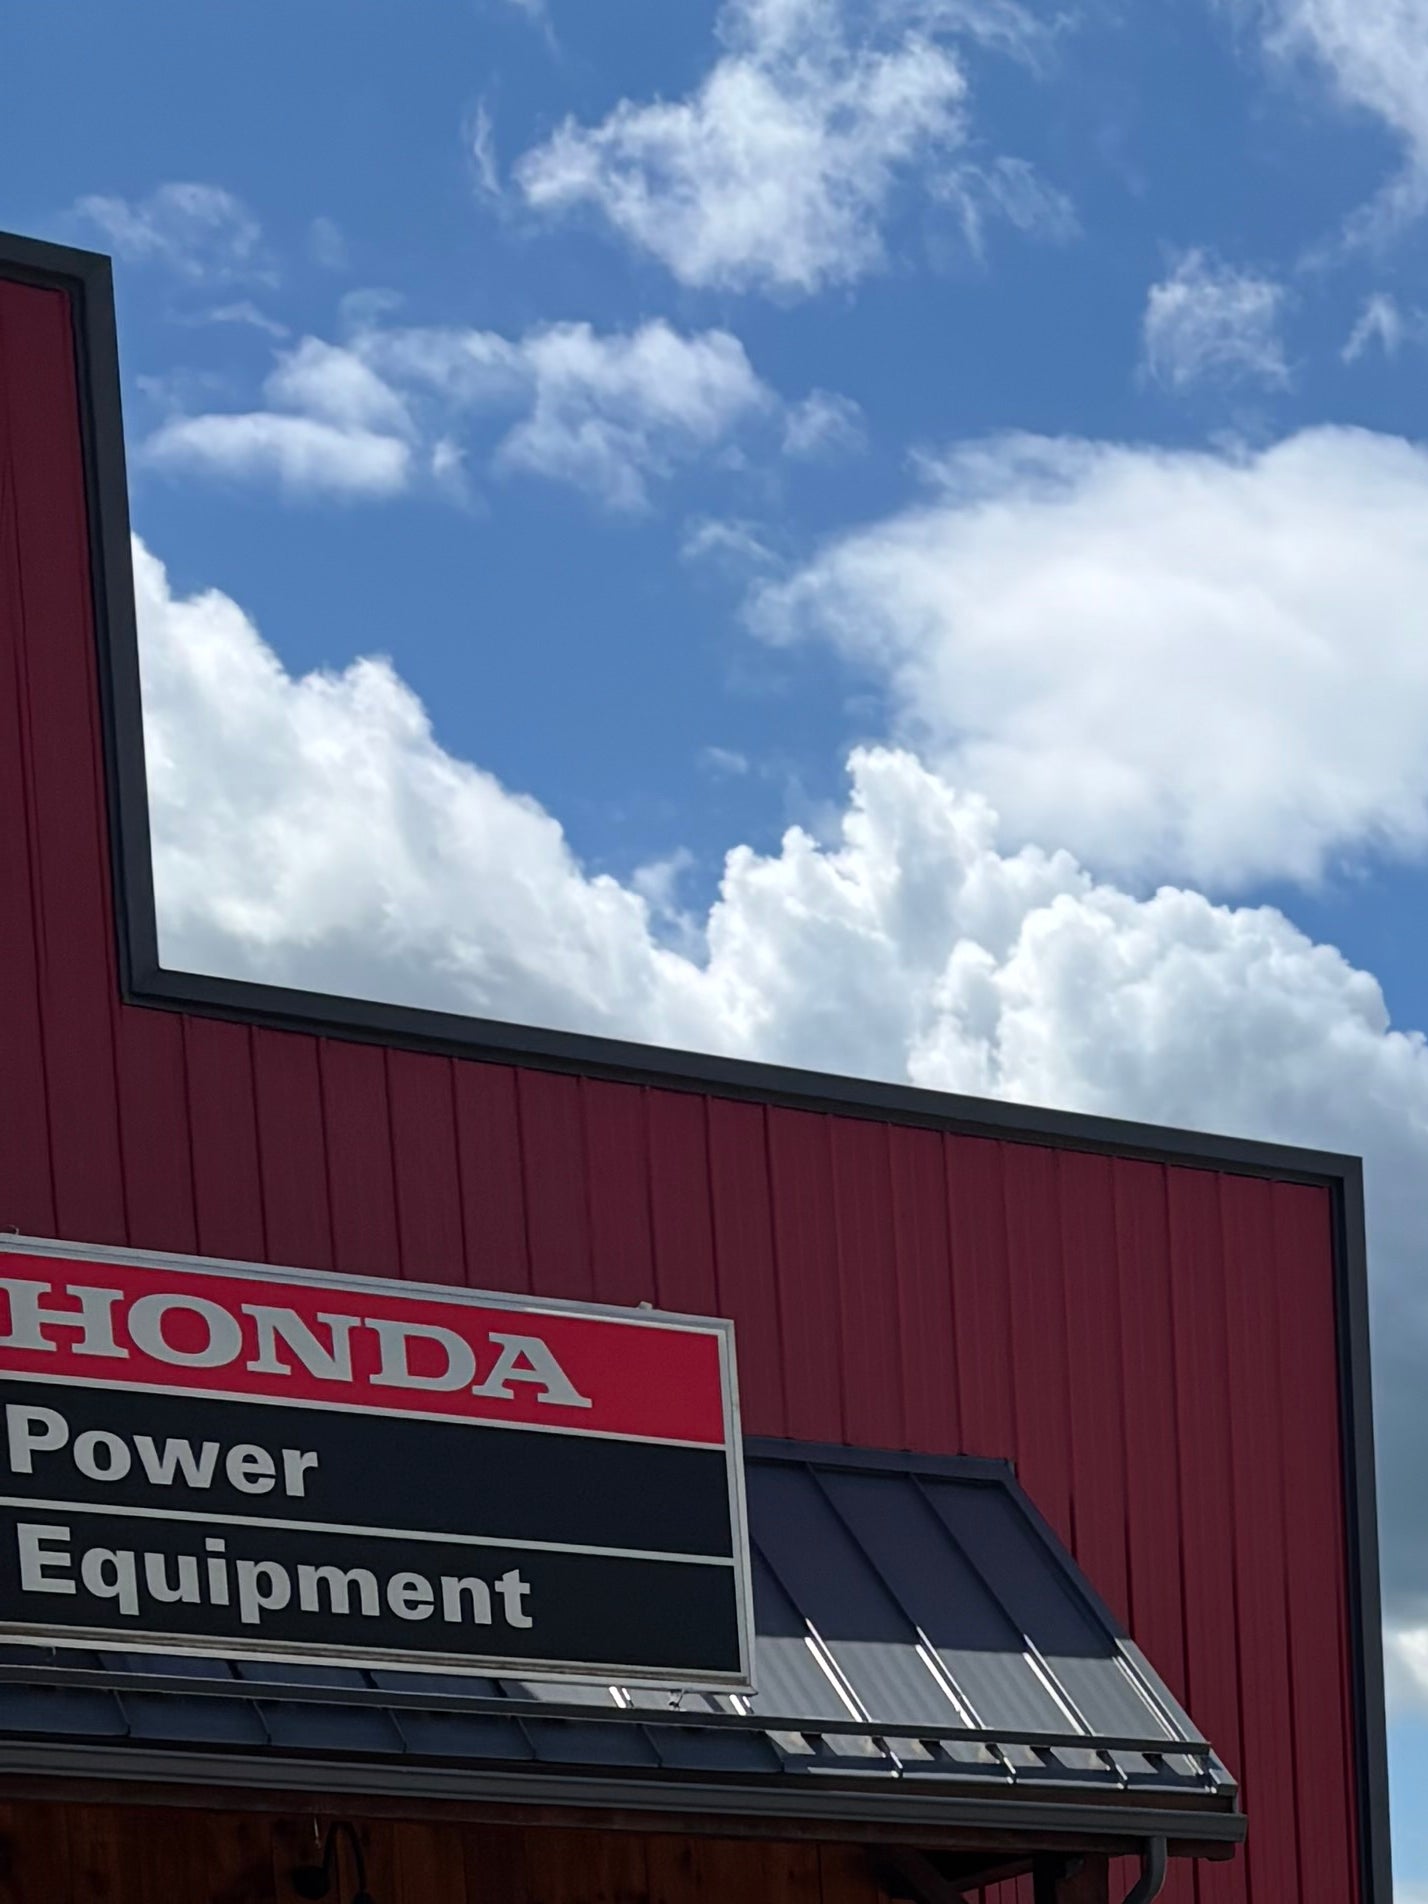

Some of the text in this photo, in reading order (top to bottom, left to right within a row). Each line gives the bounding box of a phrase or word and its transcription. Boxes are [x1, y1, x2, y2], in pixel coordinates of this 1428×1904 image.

[0, 1278, 592, 1408] HONDA
[5, 1406, 319, 1497] Power
[17, 1523, 533, 1628] Equipment
